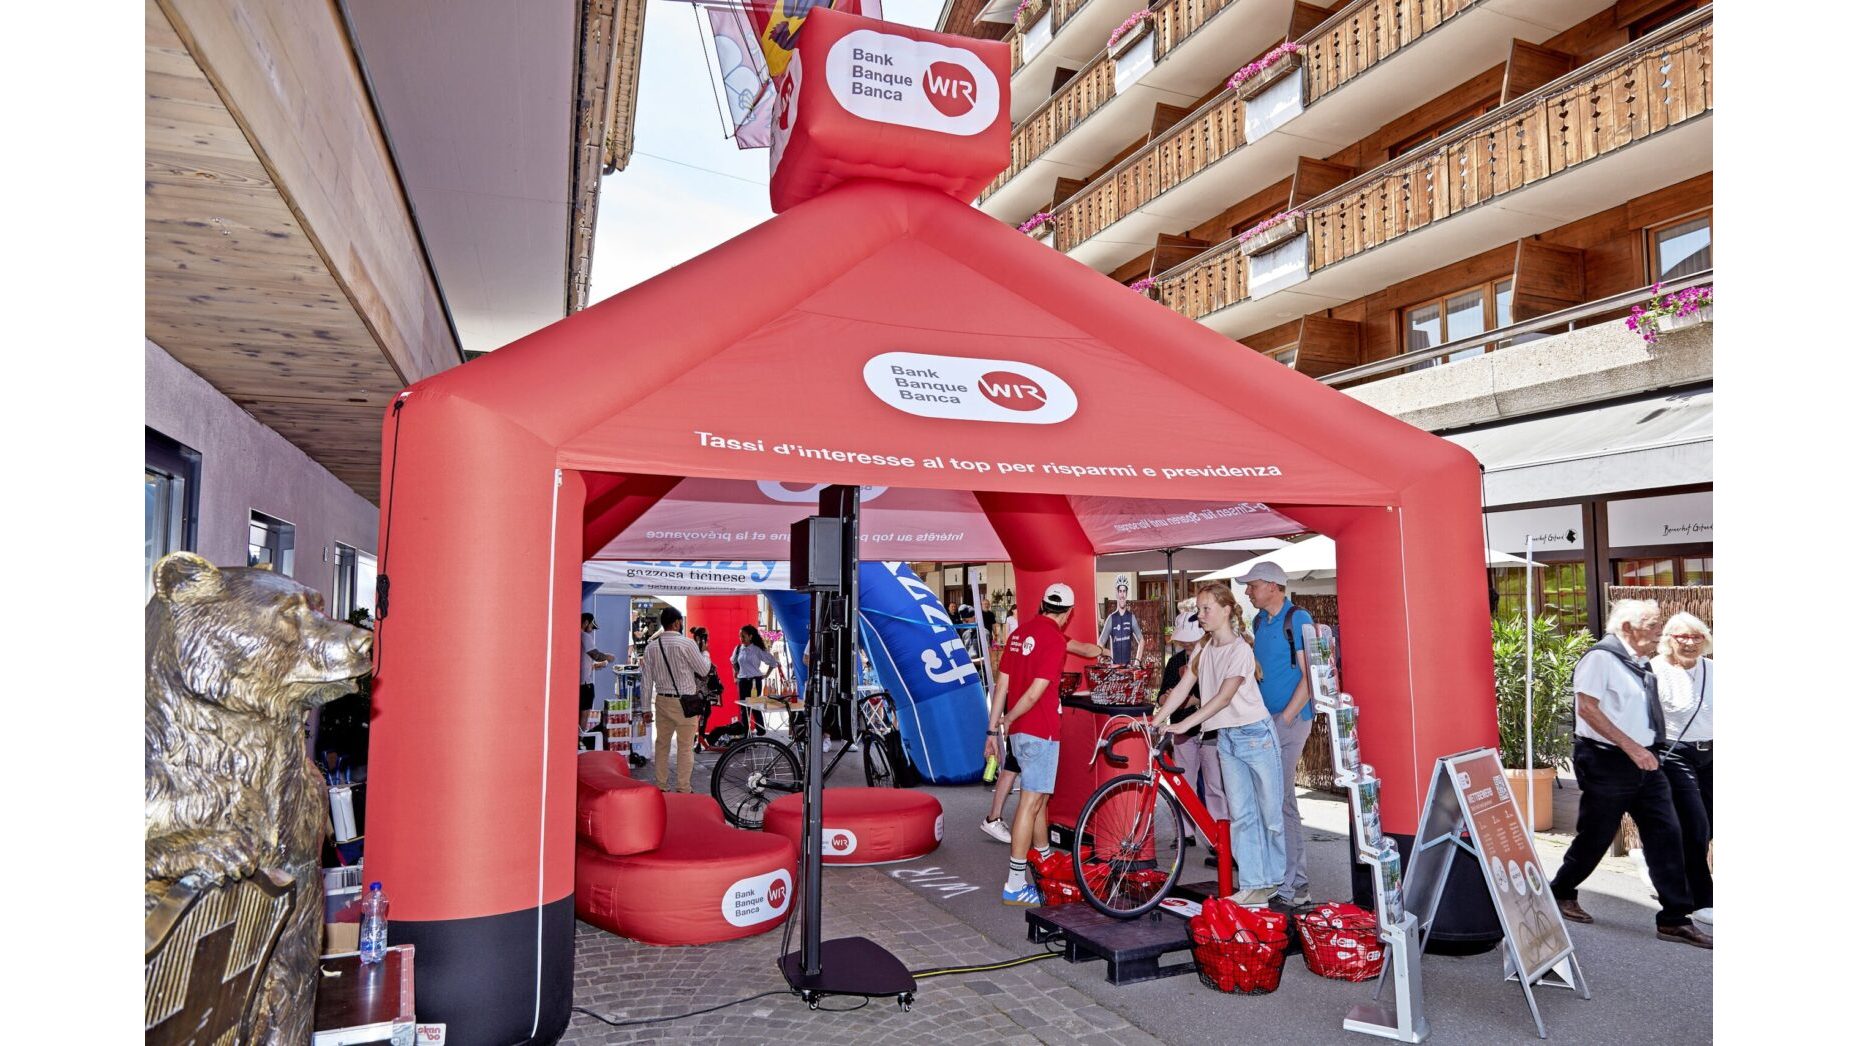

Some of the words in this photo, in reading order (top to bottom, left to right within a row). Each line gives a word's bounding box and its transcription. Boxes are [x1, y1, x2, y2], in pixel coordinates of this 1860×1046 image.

[853, 48, 893, 66] Bank
[852, 65, 913, 87] Banque
[851, 82, 903, 101] Banca
[927, 69, 976, 107] WIR
[891, 365, 940, 379] Bank
[895, 377, 968, 393] Banque
[979, 376, 1047, 402] WIR
[900, 389, 961, 404] Banca
[694, 431, 764, 452] Tassi
[773, 443, 916, 467] d'interesse
[923, 456, 943, 469] al
[950, 457, 991, 473] top
[997, 461, 1035, 475] per
[1042, 461, 1138, 477] risparmi
[1142, 466, 1157, 477] e
[1162, 465, 1283, 479] previdenza
[690, 569, 746, 583] ticinese
[832, 837, 848, 847] WIR
[892, 866, 980, 899] WIR
[735, 889, 755, 899] Bank
[735, 896, 764, 908] Banque
[768, 886, 786, 902] WIR
[735, 906, 760, 917] Banca
